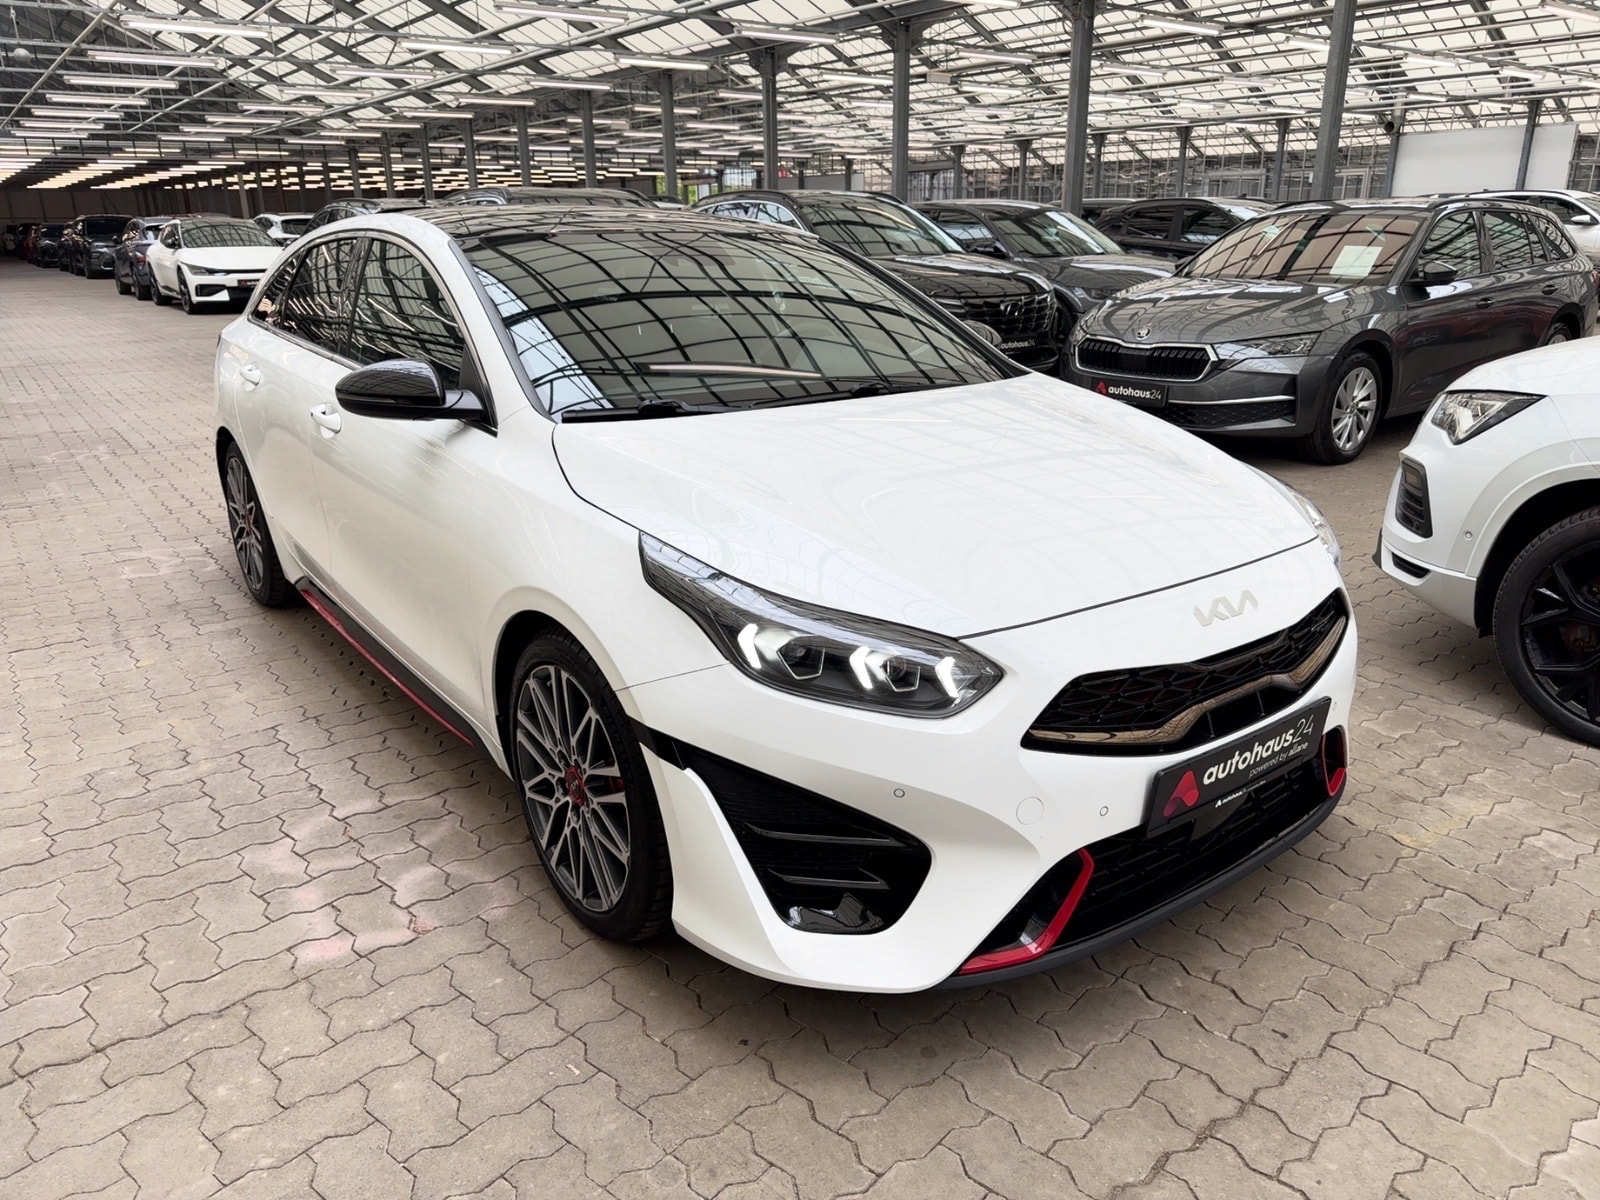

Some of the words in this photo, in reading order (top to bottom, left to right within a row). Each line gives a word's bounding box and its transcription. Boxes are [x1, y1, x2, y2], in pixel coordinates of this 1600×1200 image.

[1107, 385, 1162, 400] autohaus24
[1192, 589, 1259, 627] KIA
[1203, 714, 1314, 785] autohaus24
[1248, 754, 1280, 779] powered
[1279, 751, 1289, 762] by
